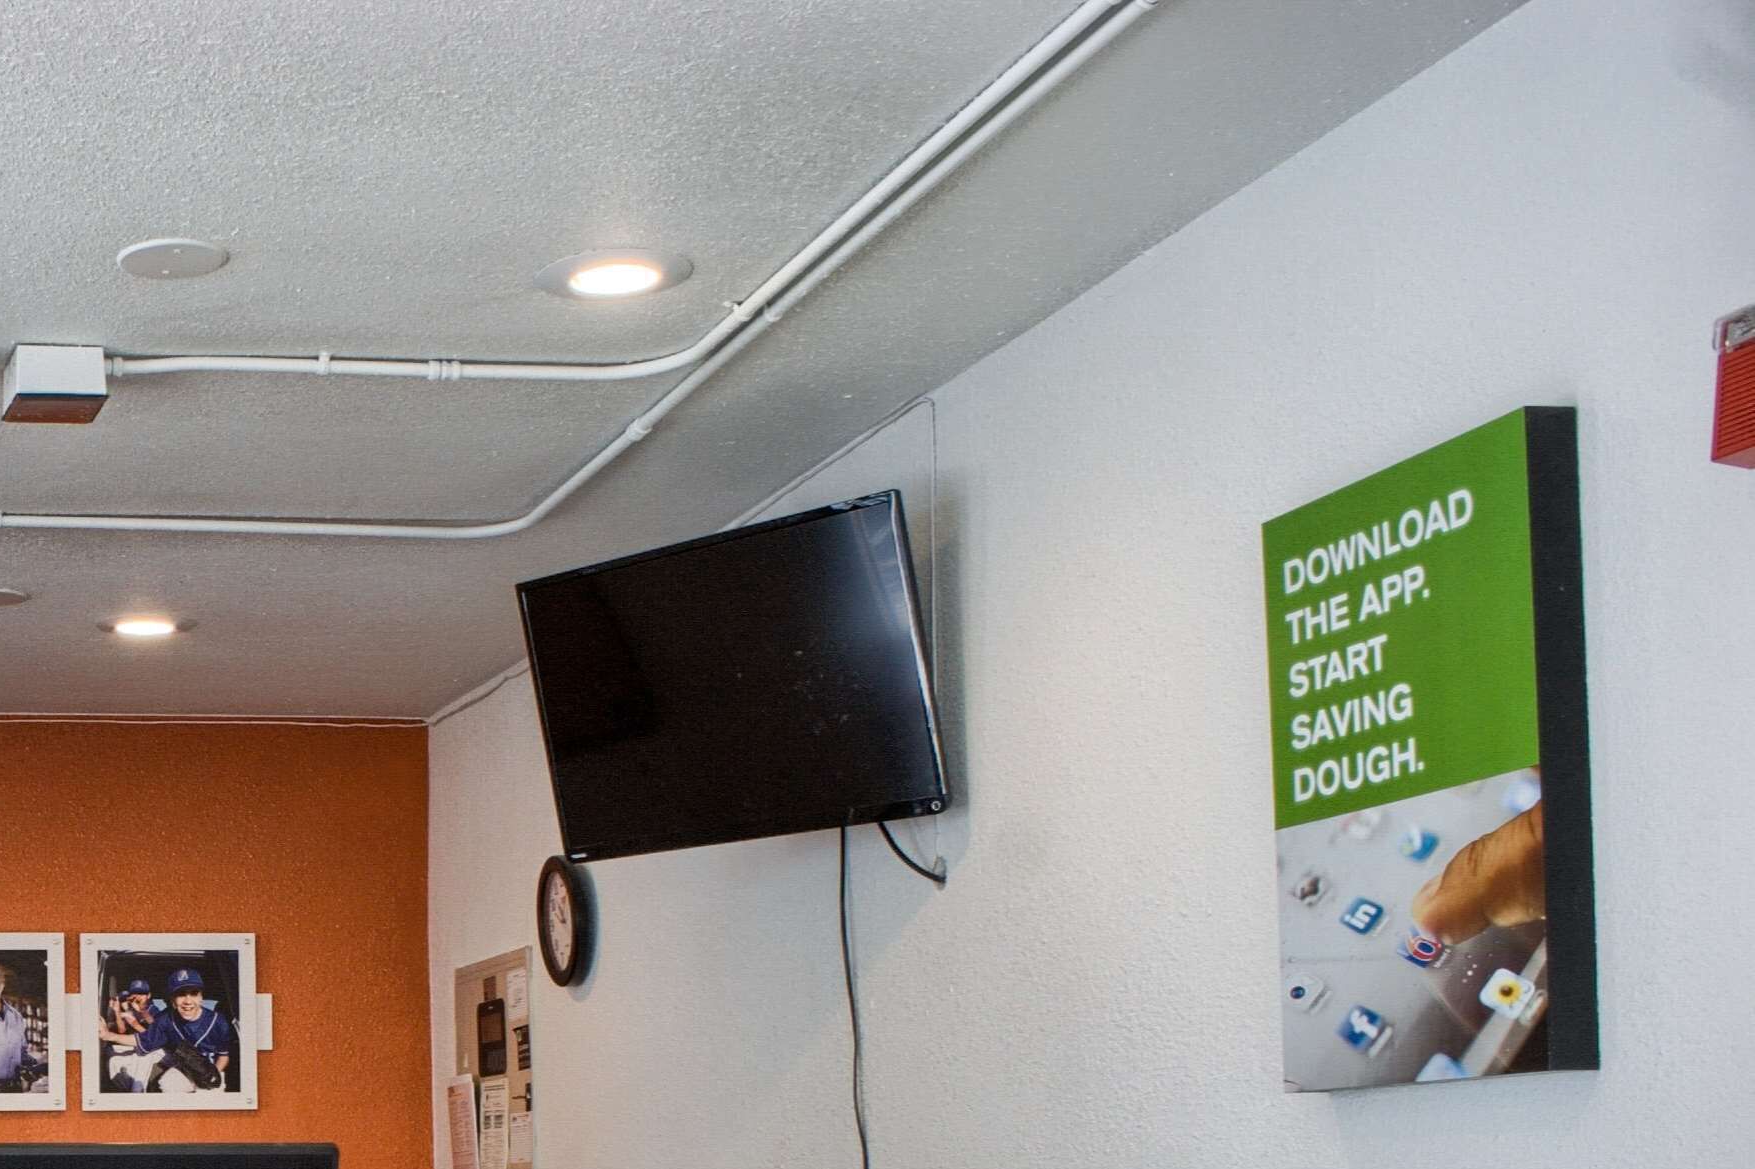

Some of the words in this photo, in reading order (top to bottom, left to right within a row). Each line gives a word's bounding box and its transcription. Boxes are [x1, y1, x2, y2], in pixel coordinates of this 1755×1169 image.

[1283, 488, 1474, 595] DOWNLOAD
[1284, 593, 1351, 645] THE
[1358, 565, 1430, 622] APP.
[1288, 634, 1389, 699] START
[1291, 682, 1414, 750] SAVING
[1293, 737, 1425, 803] DOUGH.
